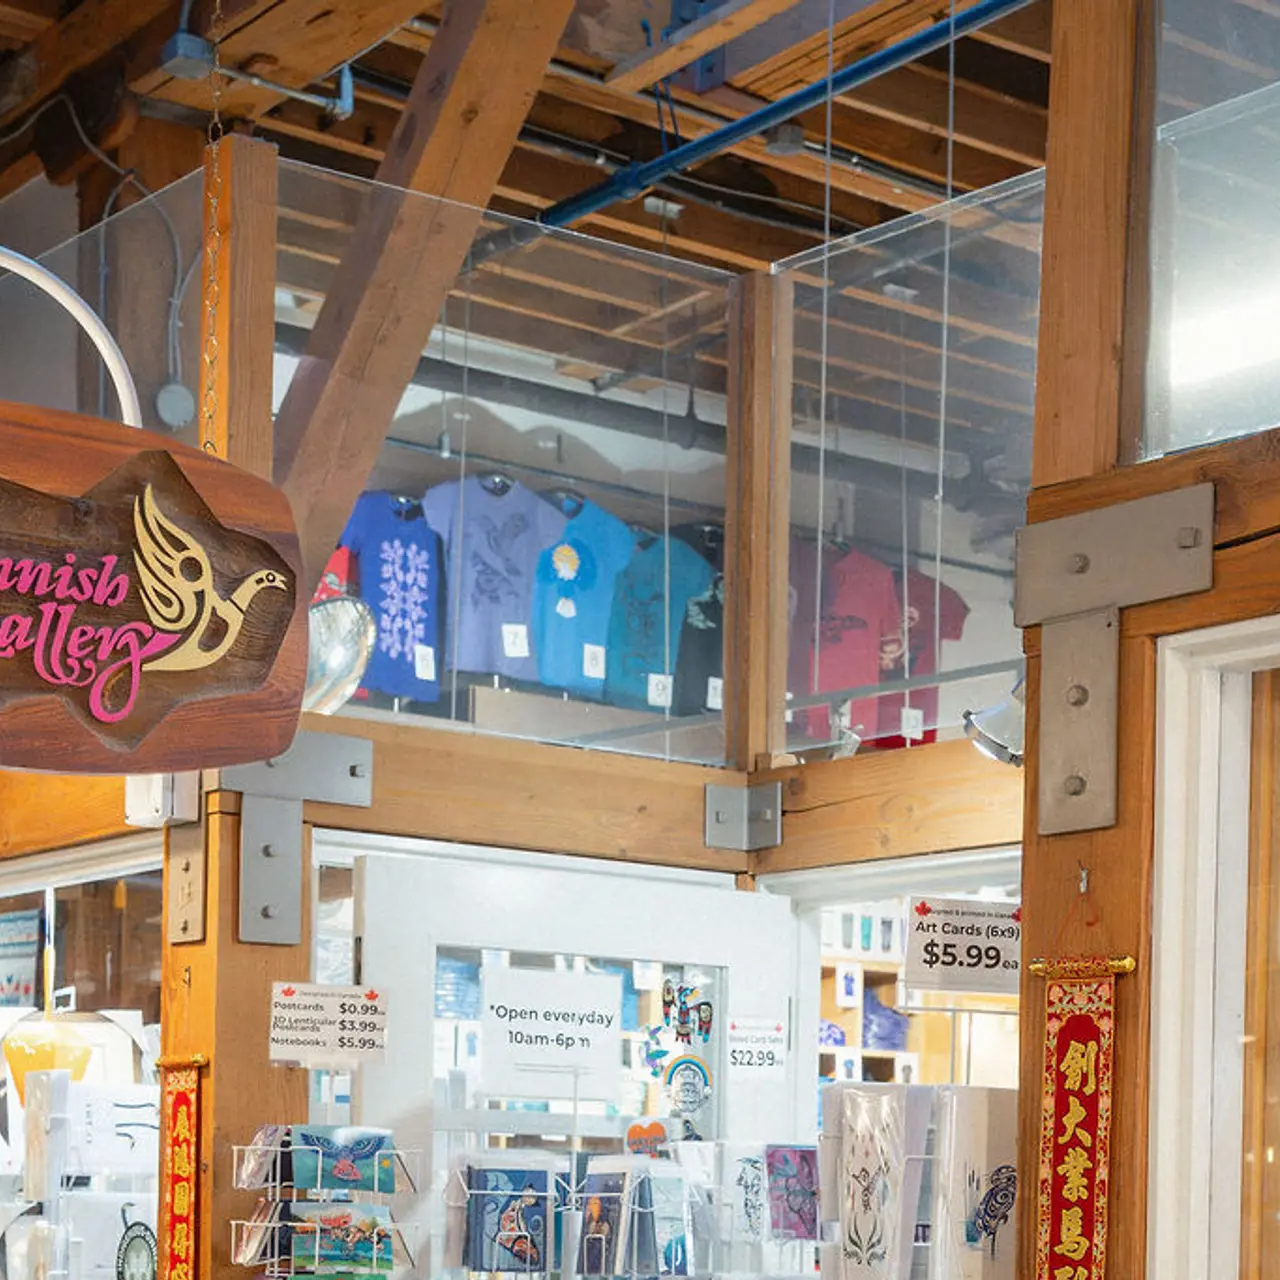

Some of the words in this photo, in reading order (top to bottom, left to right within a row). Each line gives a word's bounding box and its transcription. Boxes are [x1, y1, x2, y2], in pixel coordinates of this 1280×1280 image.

[915, 921, 938, 933] Art
[941, 922, 982, 936] Cards
[986, 924, 1020, 941] (6x9)
[274, 1001, 325, 1012] Postcards
[543, 1008, 614, 1028] everyday
[271, 1036, 327, 1047] Notebooks
